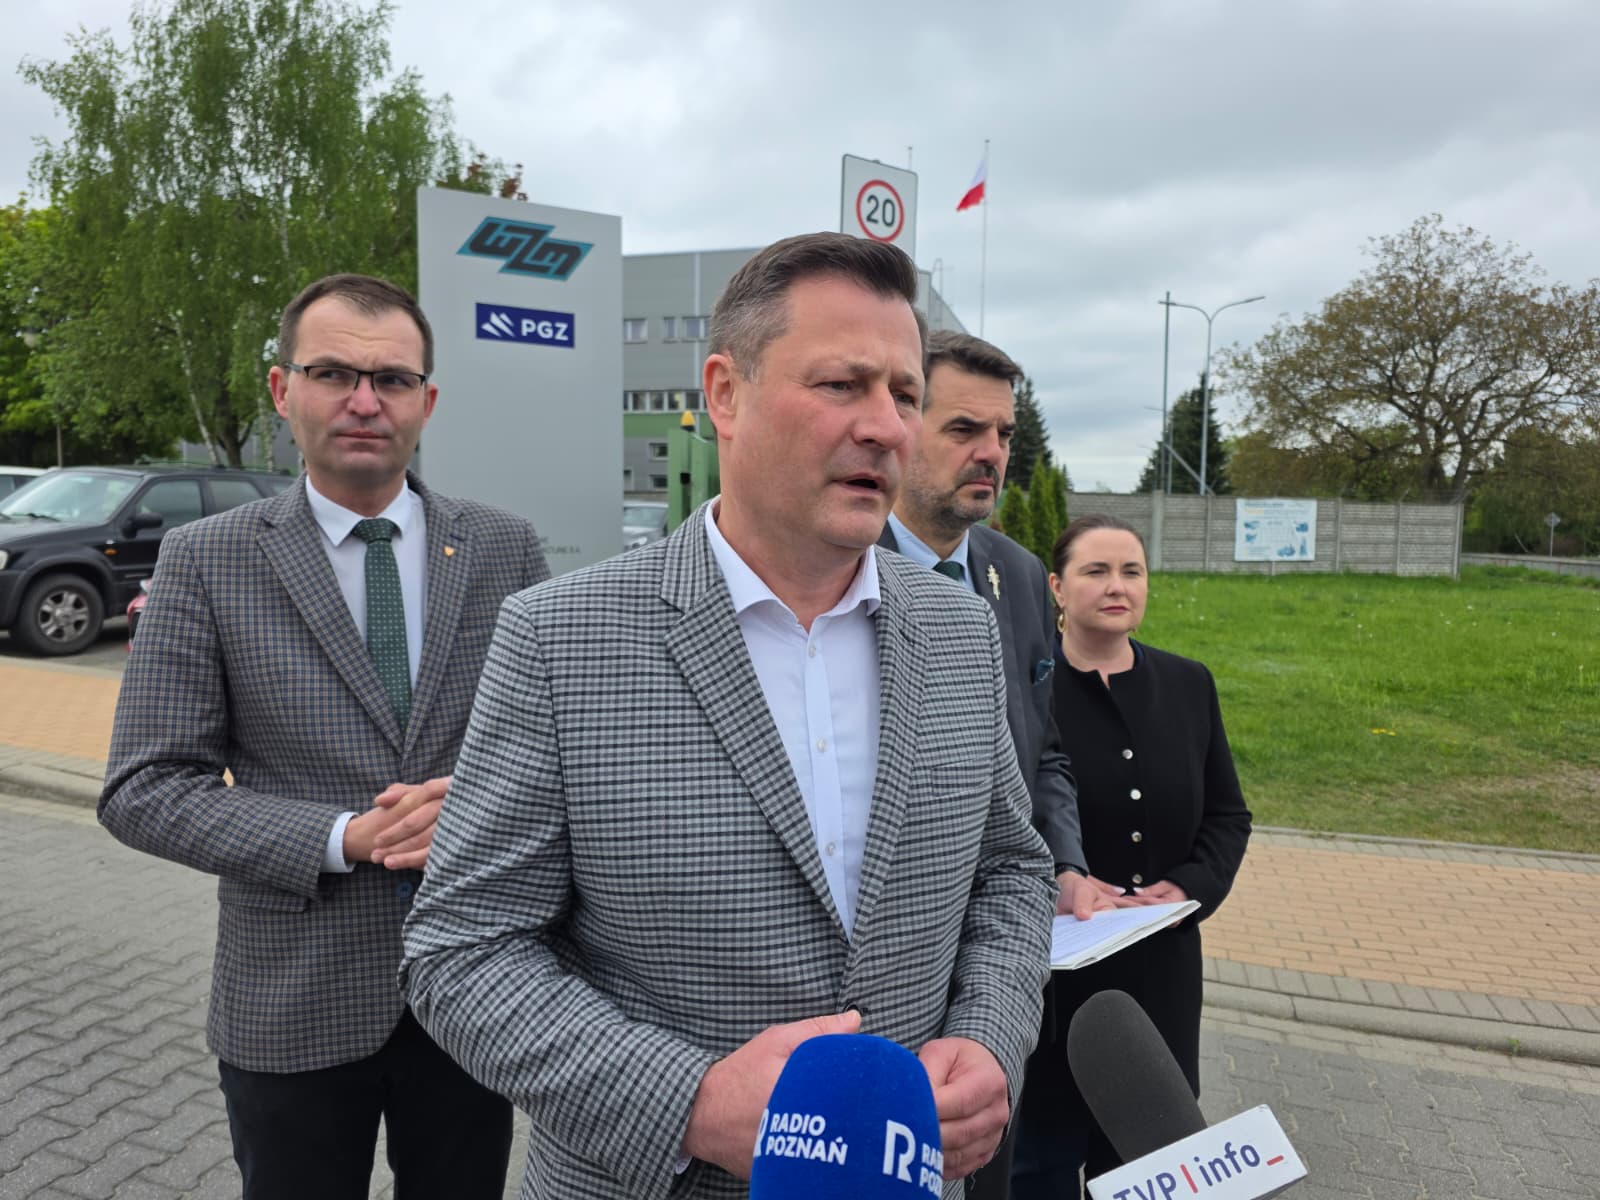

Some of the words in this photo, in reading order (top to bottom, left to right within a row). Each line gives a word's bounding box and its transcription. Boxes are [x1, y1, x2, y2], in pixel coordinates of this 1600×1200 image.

[866, 194, 896, 228] 20
[520, 318, 569, 341] PGZ
[769, 1112, 826, 1137] RADIO
[765, 1136, 849, 1166] POZNAŃ
[882, 1119, 917, 1183] R
